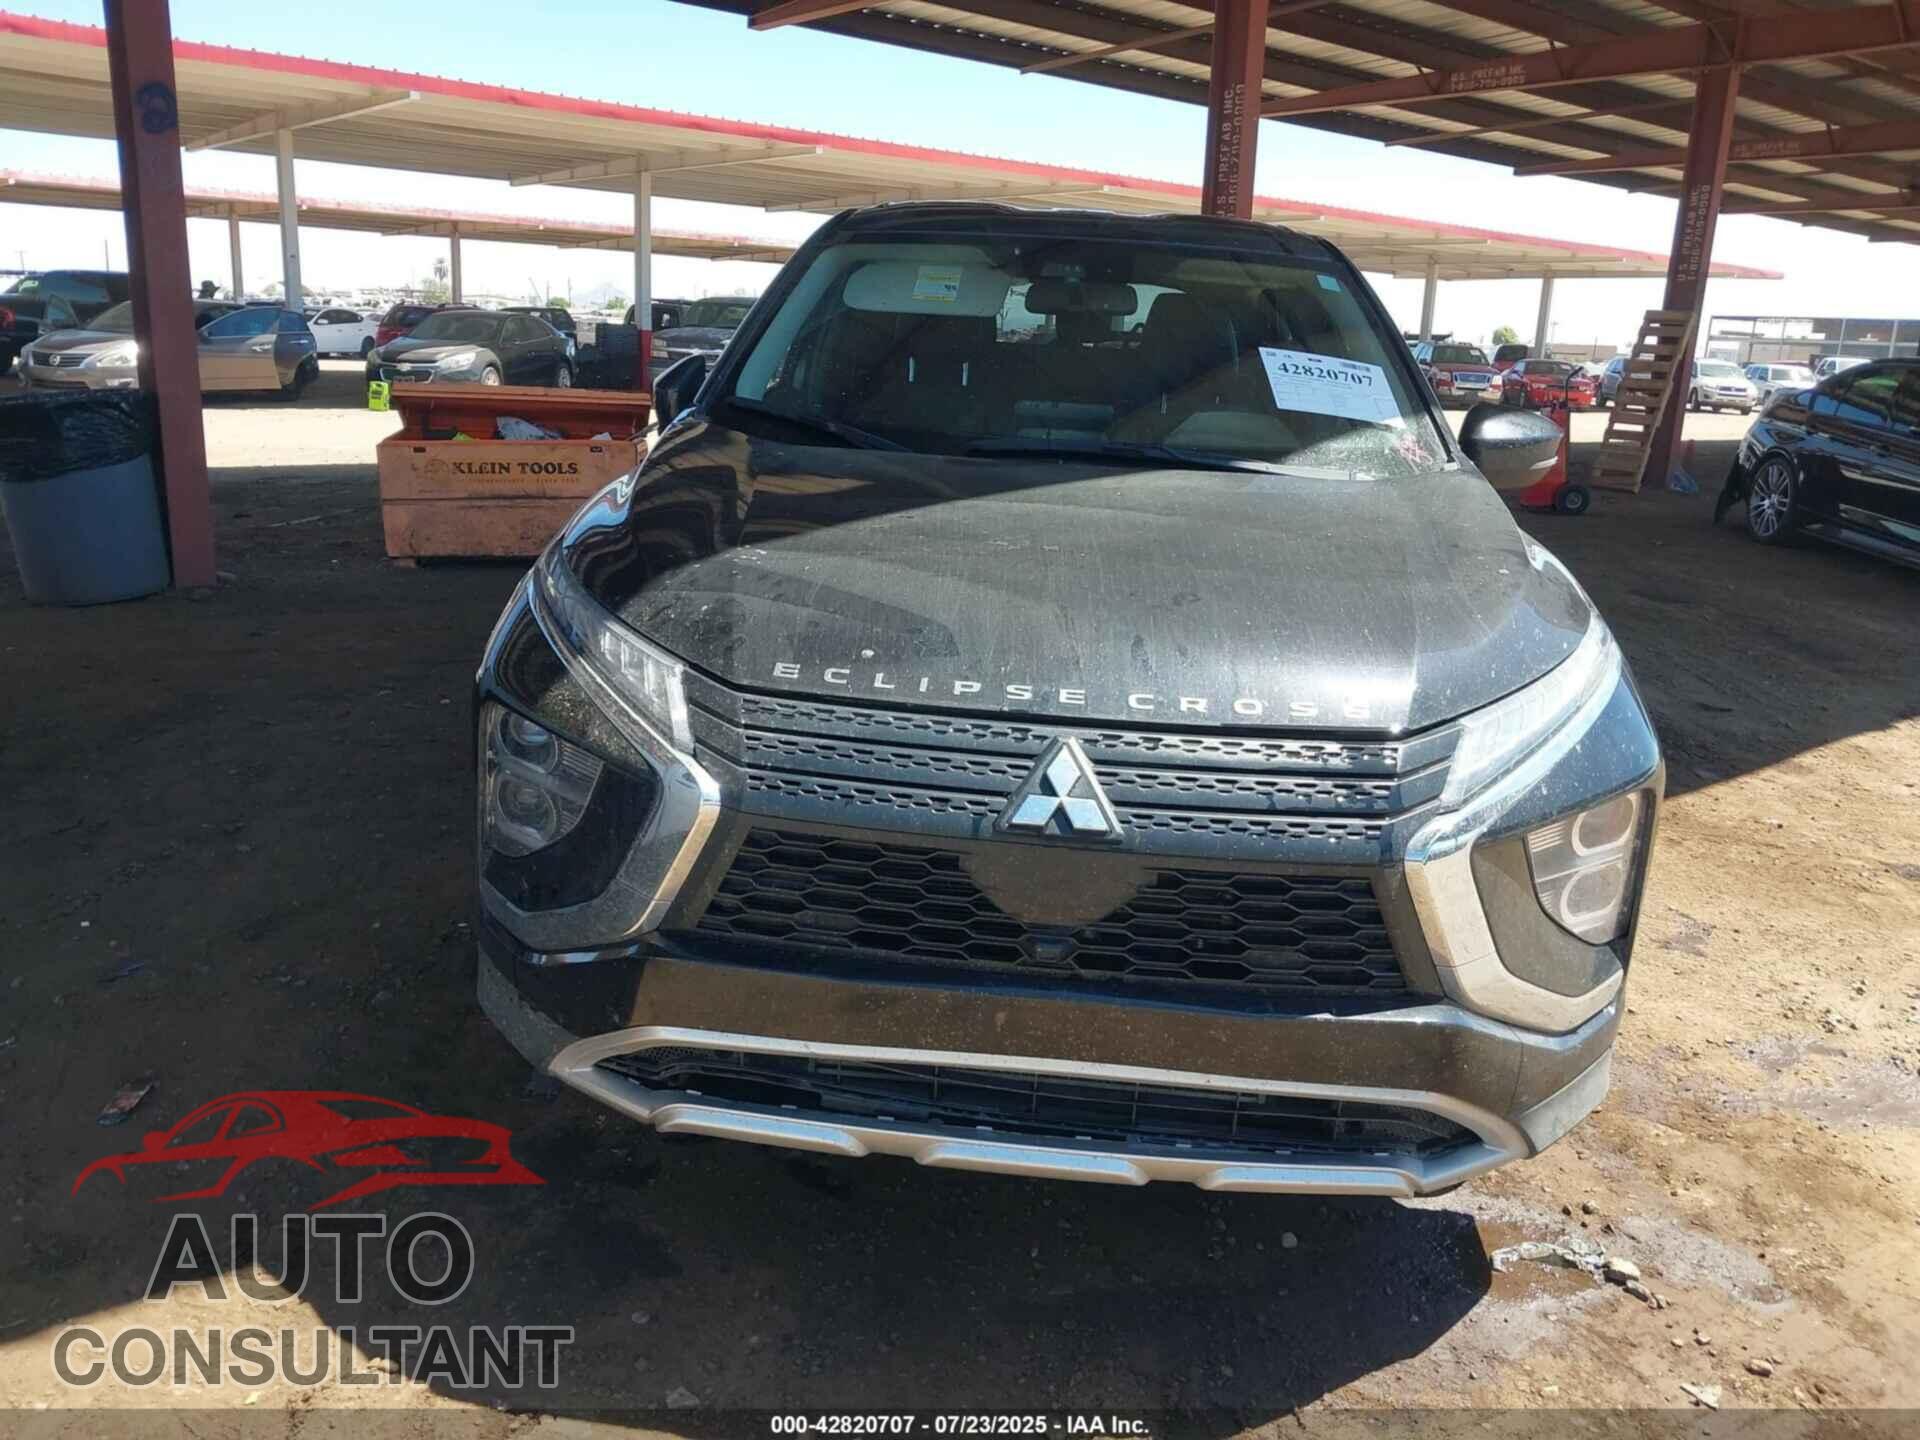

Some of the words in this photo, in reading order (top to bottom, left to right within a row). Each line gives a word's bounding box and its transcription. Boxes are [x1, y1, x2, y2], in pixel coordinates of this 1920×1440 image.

[1218, 121, 1233, 183] PREFAB
[1278, 362, 1373, 387] 42820707
[453, 462, 511, 475] KLEIN
[517, 462, 578, 475] TOOLS
[772, 661, 1089, 705] ECLIPSE
[1127, 692, 1373, 720] CROSS
